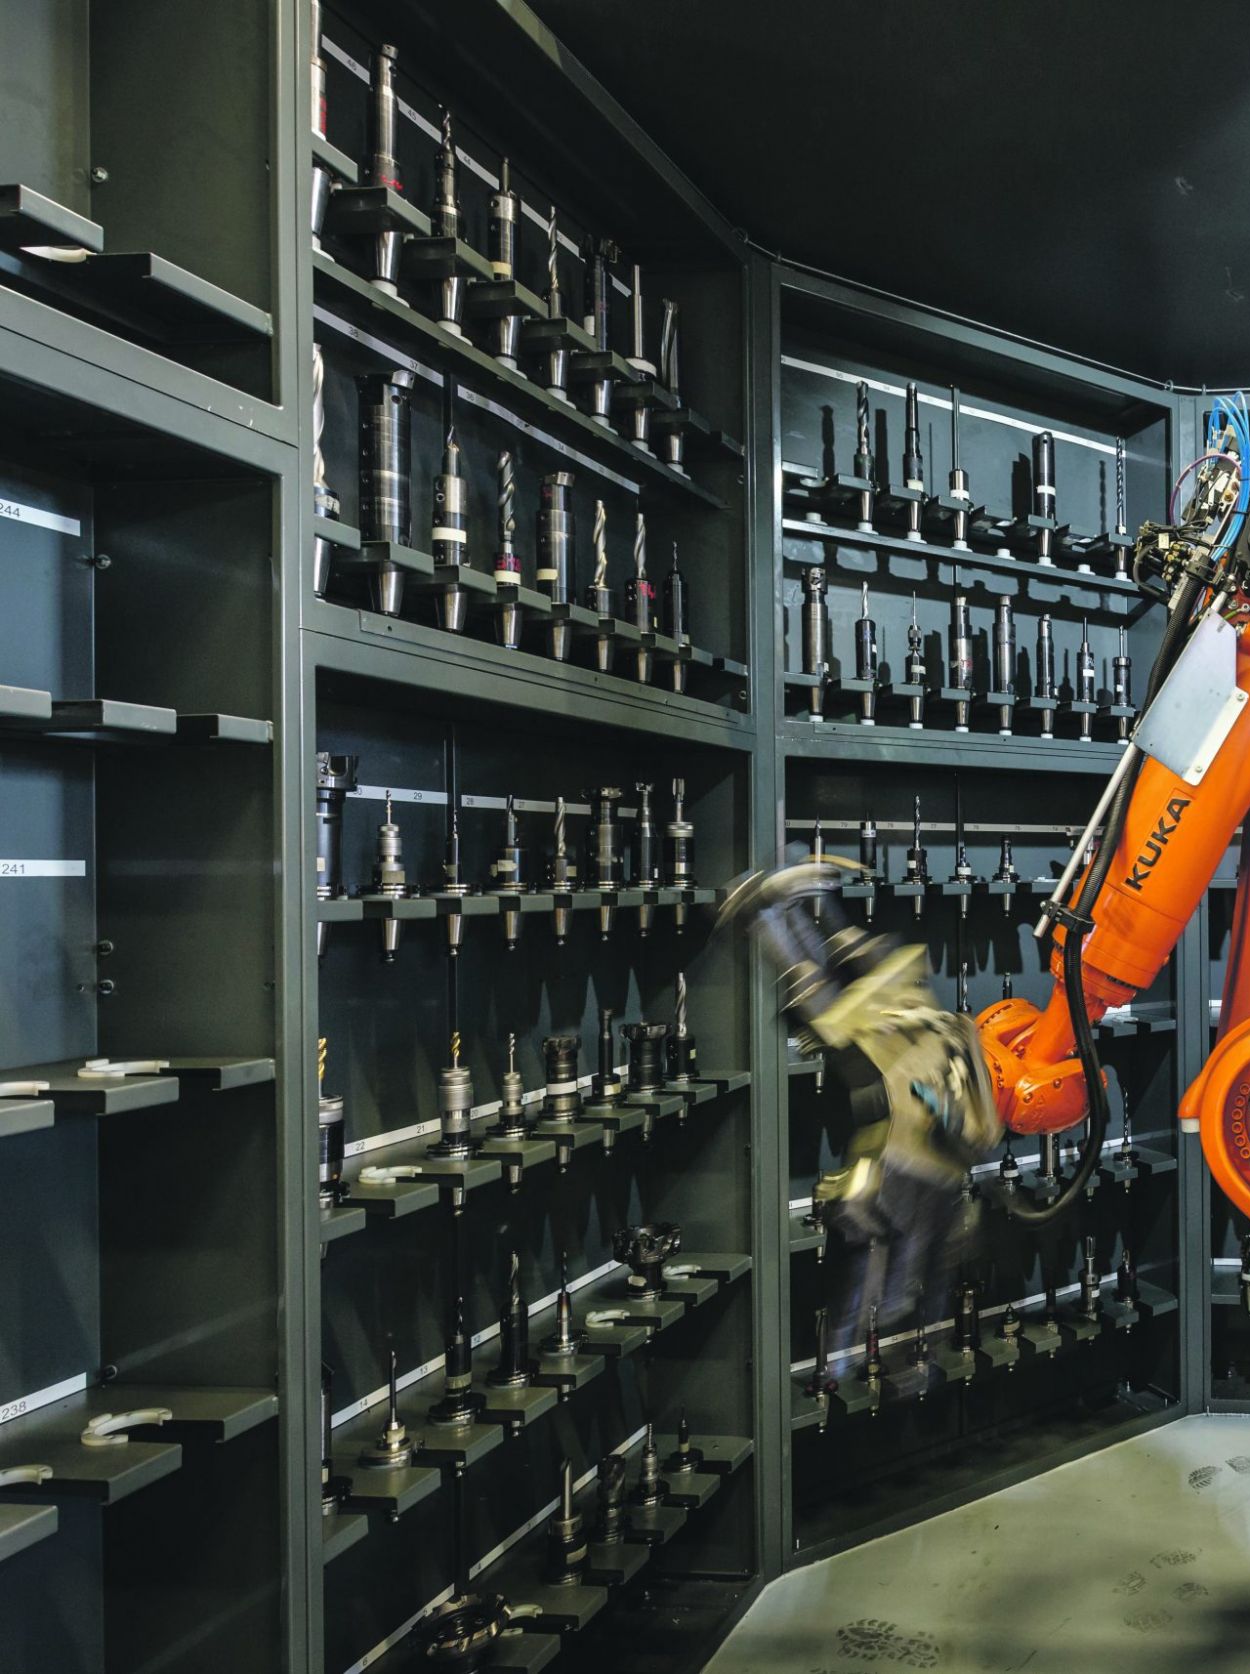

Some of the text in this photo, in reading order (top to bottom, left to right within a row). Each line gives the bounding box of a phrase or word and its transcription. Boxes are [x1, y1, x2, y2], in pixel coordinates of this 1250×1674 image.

[409, 359, 418, 370] 37
[413, 788, 423, 799] 29
[1125, 798, 1192, 891] KUKA
[2, 863, 25, 875] 241
[356, 1124, 426, 1151] 22 21
[360, 1364, 428, 1409] 14 13
[2, 1401, 26, 1420] 238
